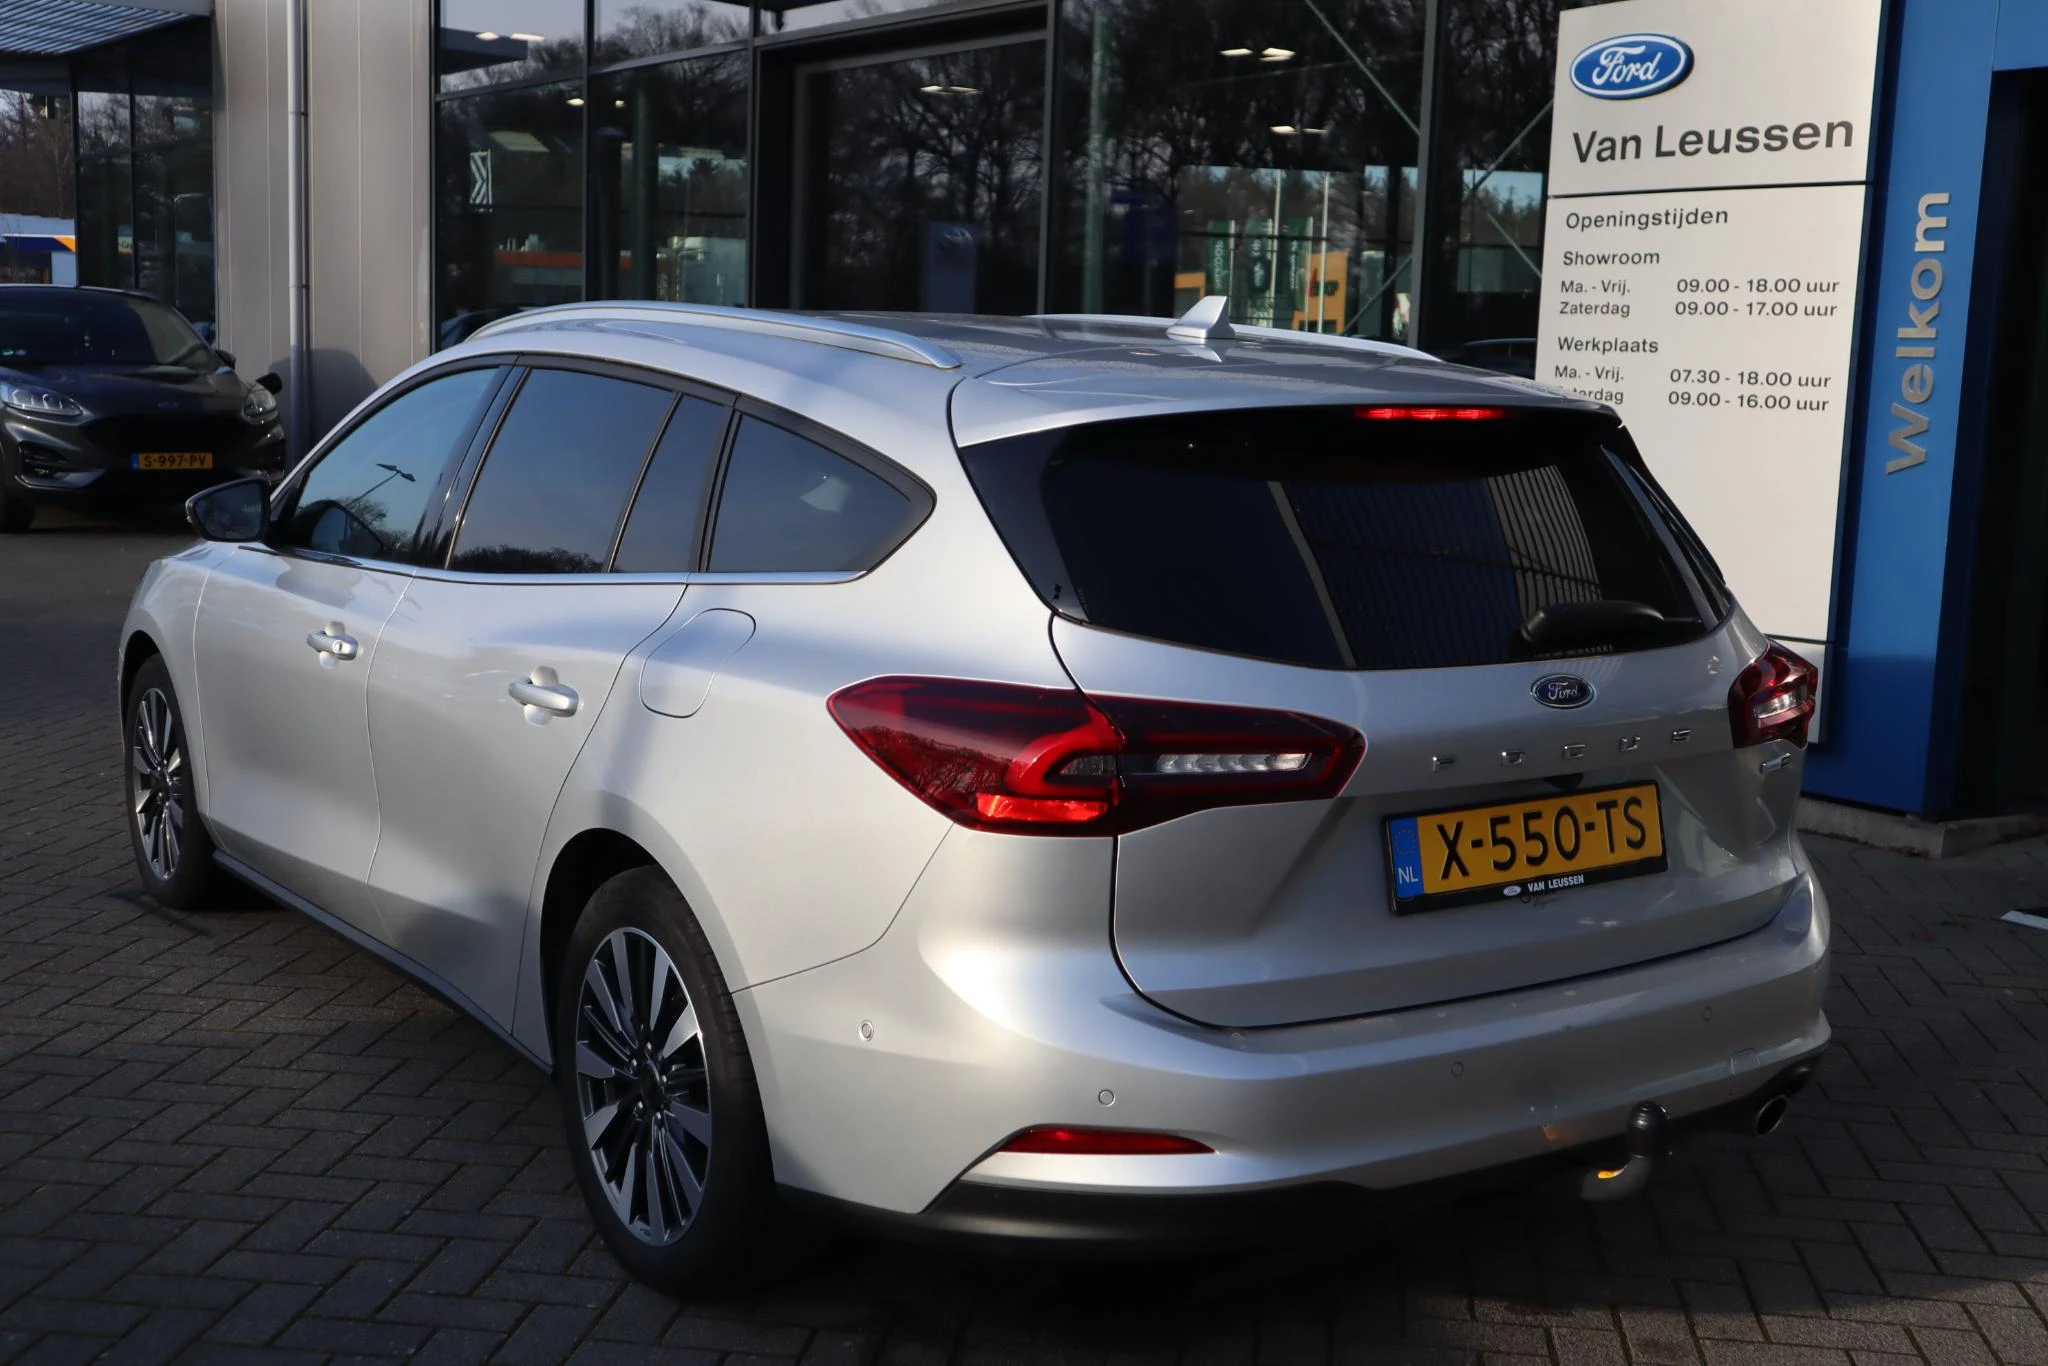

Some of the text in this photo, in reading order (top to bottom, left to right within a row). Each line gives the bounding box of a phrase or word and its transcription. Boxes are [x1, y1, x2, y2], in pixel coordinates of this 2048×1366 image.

[1592, 45, 1662, 85] Ford
[1572, 119, 1853, 163] Van Leussen
[1566, 209, 1728, 232] Openingstijden
[1563, 251, 1660, 266] Showroom
[1560, 281, 1588, 293] Ma.
[1601, 280, 1631, 295] Vrij.
[1677, 279, 1730, 293] 09.00
[1747, 278, 1801, 293] 18.00
[1806, 281, 1840, 293] uur
[1559, 302, 1630, 318] Zaterdag
[1675, 302, 1729, 316] 09.00
[1746, 302, 1798, 316] 17.00
[1804, 304, 1838, 316] uur
[1884, 192, 1950, 474] Welkom
[1558, 337, 1658, 356] Werkplaats
[1555, 366, 1581, 379] Ma.
[1595, 367, 1624, 381] Vrij.
[1670, 369, 1720, 384] 07.30
[1737, 371, 1792, 387] 18.00
[1798, 375, 1831, 387] uur
[1558, 386, 1624, 405] rdag
[1668, 392, 1721, 406] 09.00
[1737, 395, 1791, 410] 16.00
[1796, 399, 1829, 411] uur
[143, 455, 207, 467] S-997-PV
[1548, 682, 1579, 700] Ford
[1437, 797, 1647, 881] X-550-TS
[1398, 867, 1419, 884] NL
[1528, 881, 1545, 892] VAN
[1548, 874, 1584, 888] LEUSSEN
